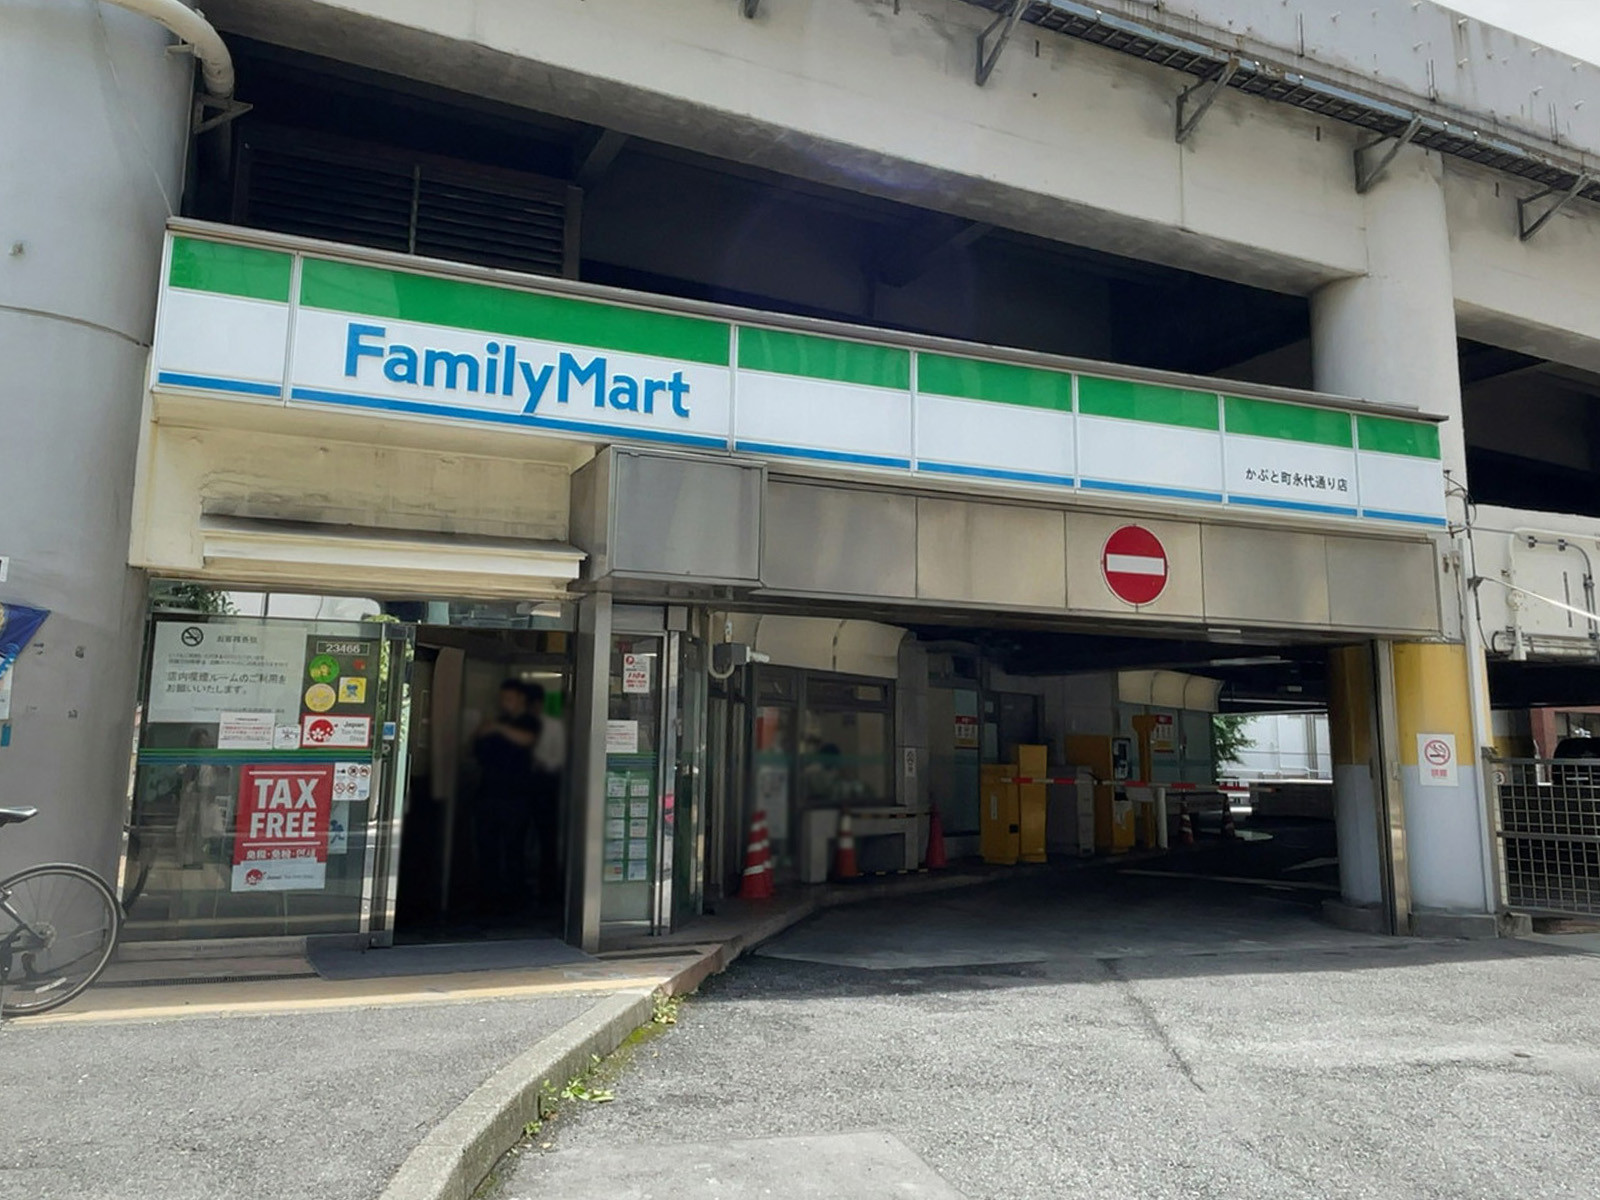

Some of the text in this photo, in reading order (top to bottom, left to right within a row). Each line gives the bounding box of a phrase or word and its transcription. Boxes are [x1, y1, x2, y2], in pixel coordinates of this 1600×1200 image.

[345, 322, 690, 418] FamilyMart
[1246, 468, 1348, 492] かぶと町永代通り店
[166, 684, 247, 694] お願いいたします。
[254, 779, 319, 809] TAX
[250, 812, 317, 838] FREE
